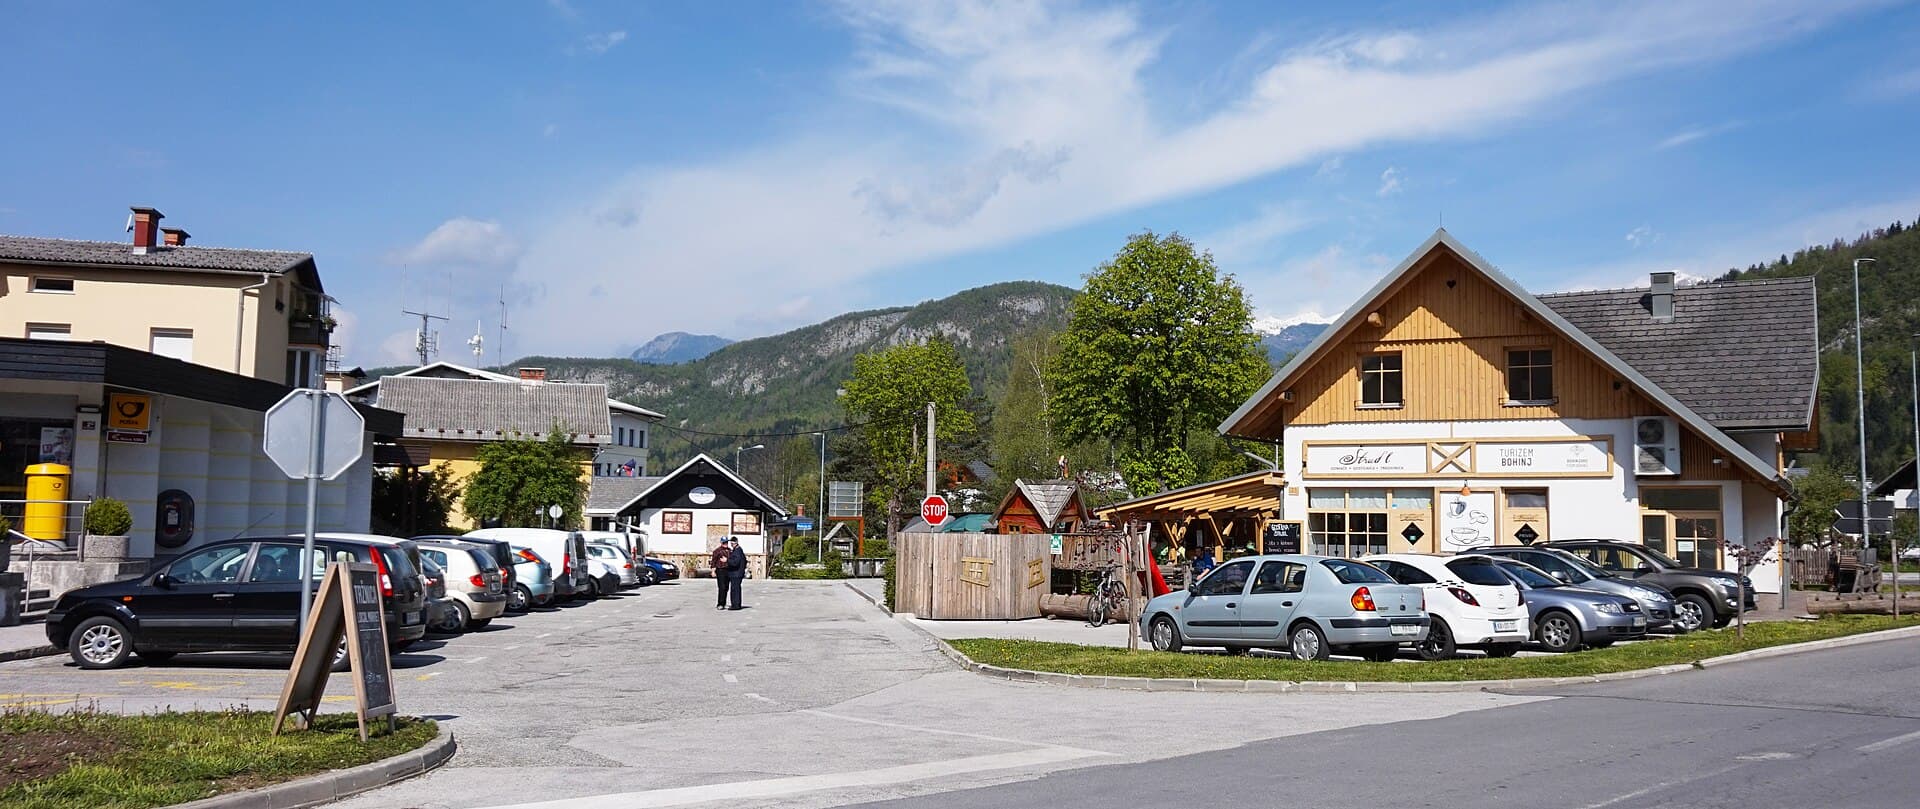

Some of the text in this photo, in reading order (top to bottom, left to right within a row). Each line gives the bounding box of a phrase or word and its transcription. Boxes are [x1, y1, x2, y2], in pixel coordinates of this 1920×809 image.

[1499, 448, 1534, 457] TURIZEM
[1501, 458, 1532, 467] BOHINJ
[923, 504, 946, 517] STOP
